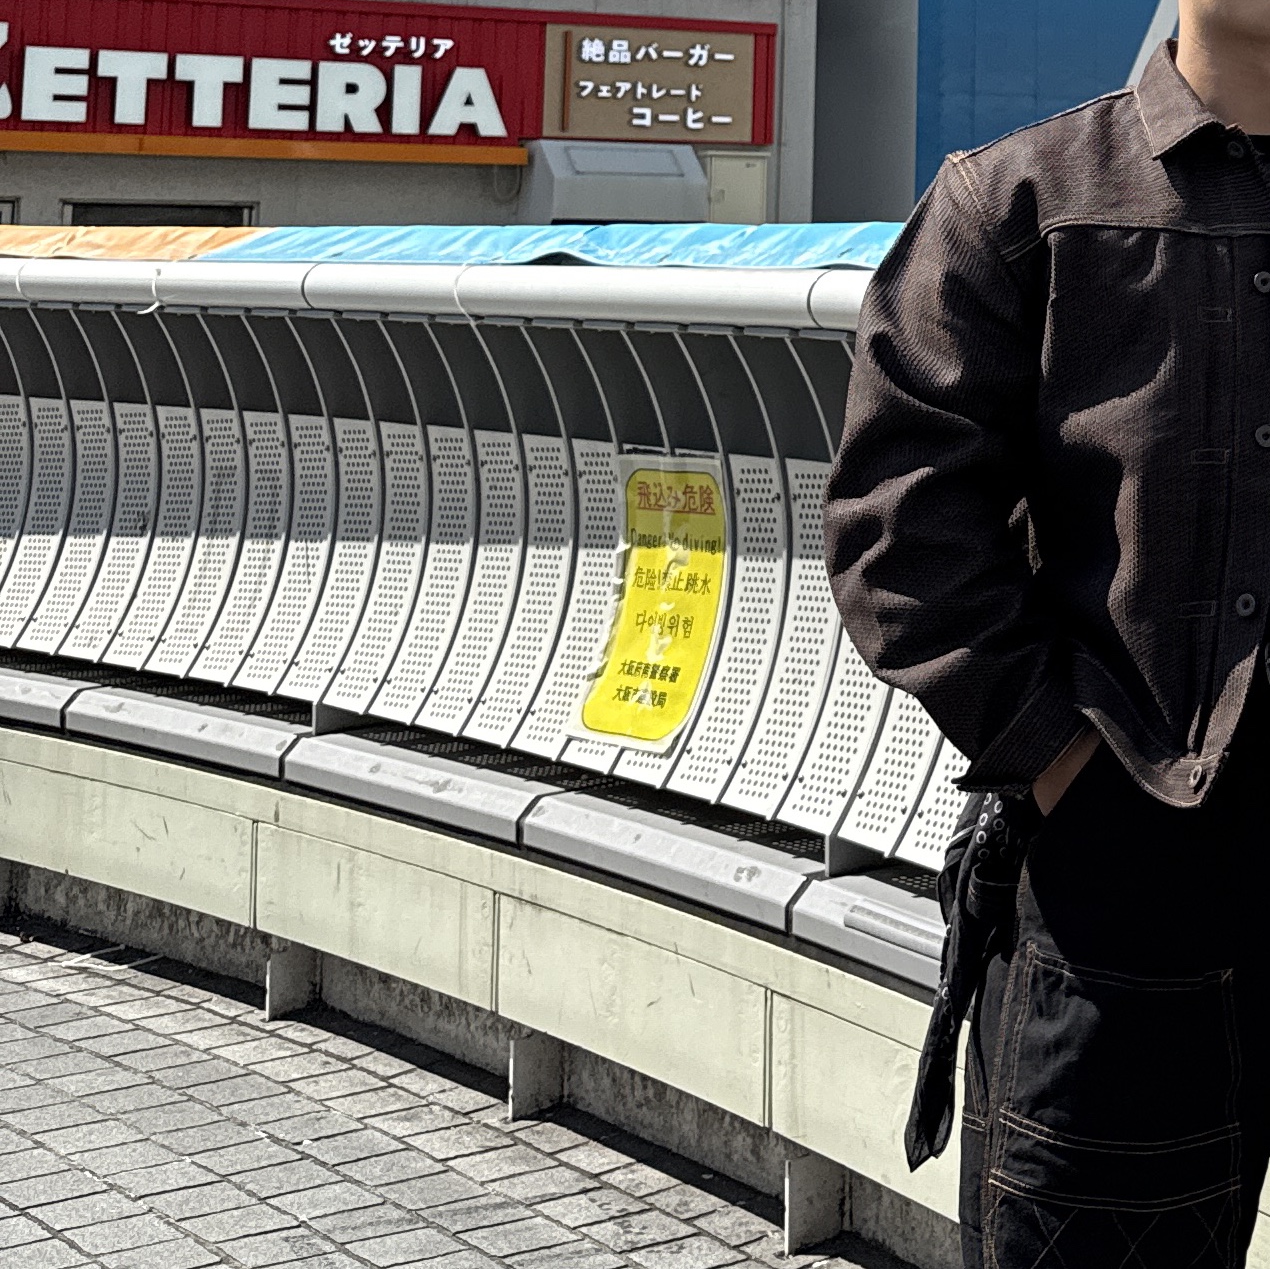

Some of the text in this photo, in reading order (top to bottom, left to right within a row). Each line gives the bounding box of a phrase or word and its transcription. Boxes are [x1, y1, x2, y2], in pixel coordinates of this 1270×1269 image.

[328, 32, 455, 59] ゼッテリア
[580, 37, 735, 67] 絶品バーガー
[0, 20, 508, 138] ETTERIA
[578, 80, 703, 102] フェアトレード
[631, 107, 733, 130] コーヒー
